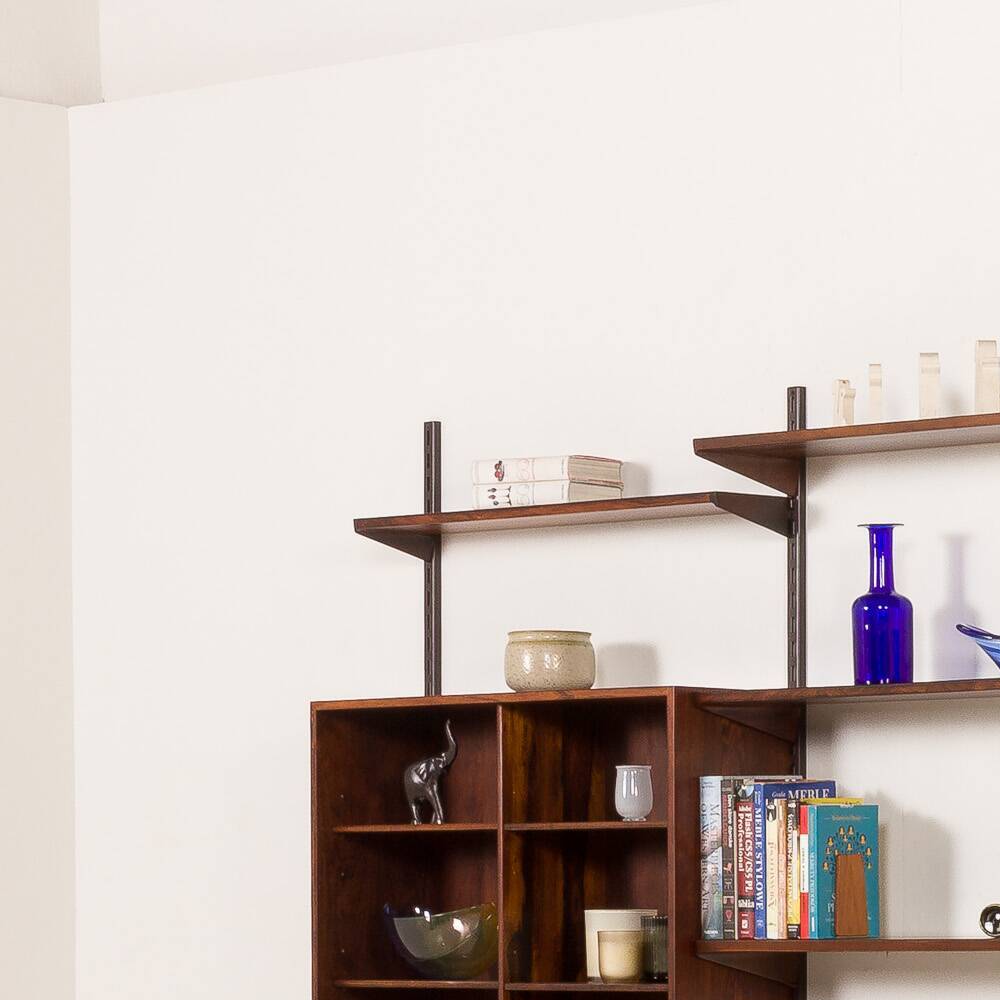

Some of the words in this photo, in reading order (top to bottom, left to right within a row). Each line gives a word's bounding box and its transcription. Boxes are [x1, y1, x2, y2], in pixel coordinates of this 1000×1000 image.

[744, 813, 753, 838] Flash
[755, 807, 763, 849] MEBLE
[744, 839, 753, 879] CS5/CS5
[745, 880, 753, 893] PL
[755, 852, 764, 910] STYLOWE
